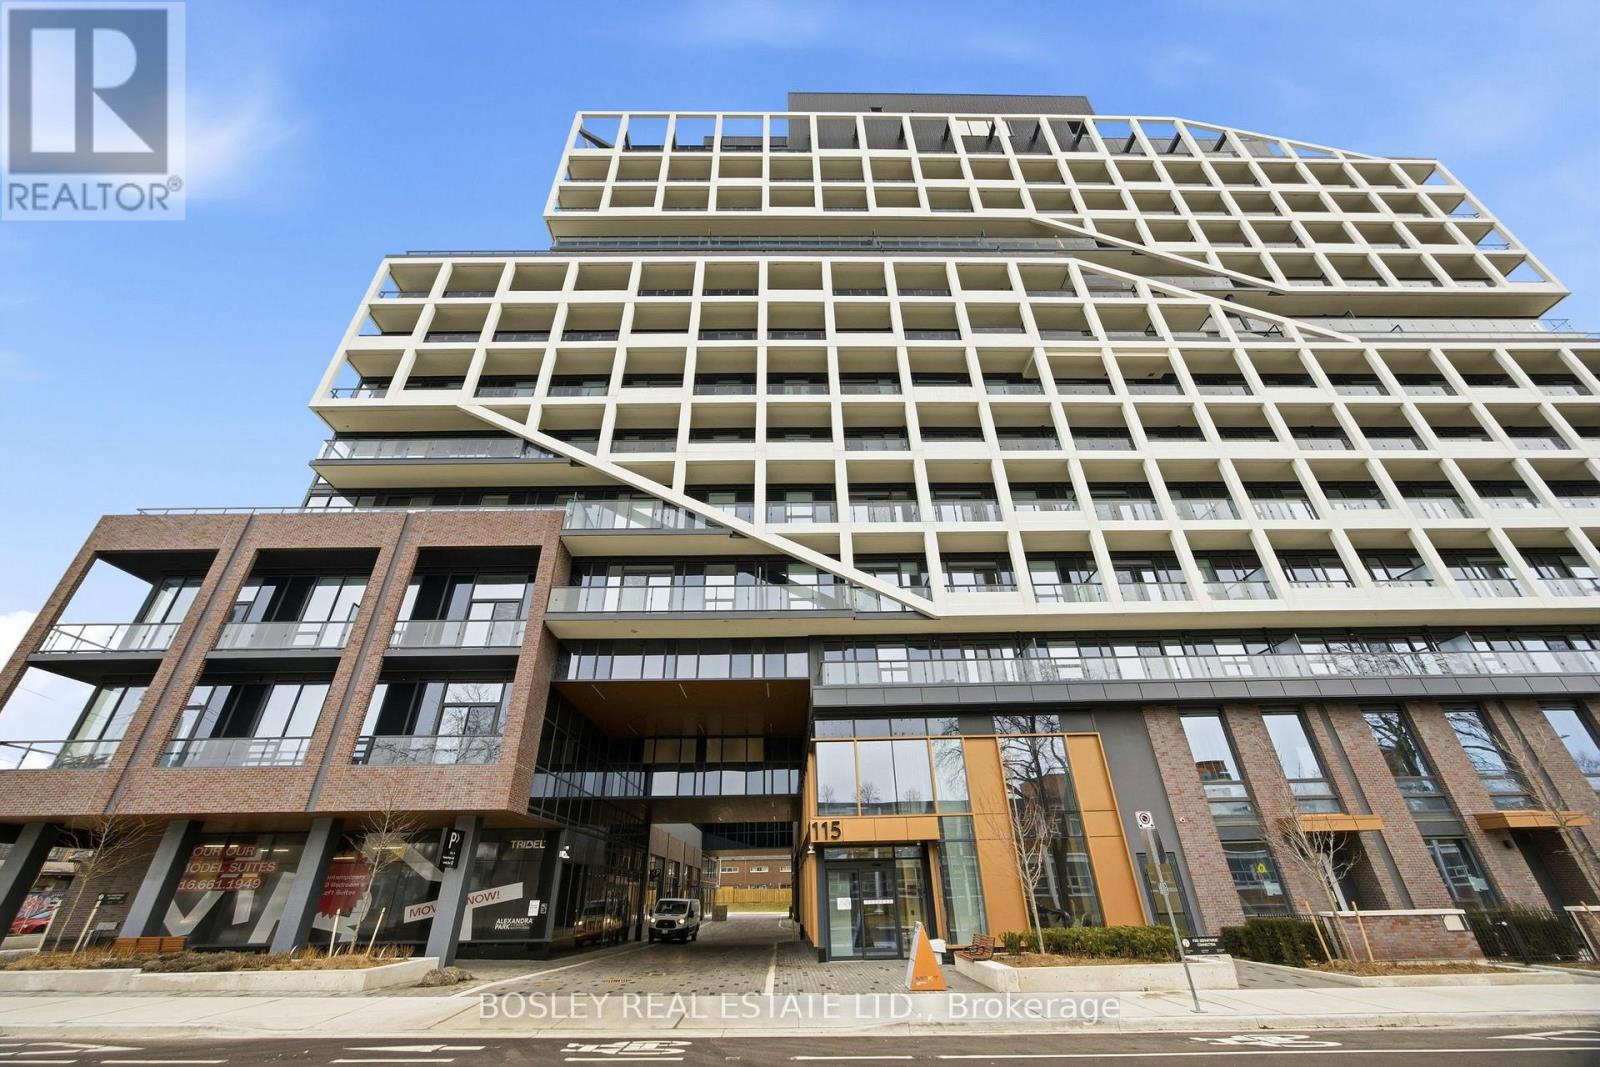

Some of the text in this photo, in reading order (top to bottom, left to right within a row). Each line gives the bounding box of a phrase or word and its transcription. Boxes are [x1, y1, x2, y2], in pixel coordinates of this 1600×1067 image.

[811, 820, 842, 840] 115
[511, 840, 545, 849] TRIDEL
[192, 846, 257, 857] OUR OUR
[229, 862, 277, 872] SUITES
[178, 879, 261, 890] 16.661.1949
[409, 890, 500, 919] MOV NOW!
